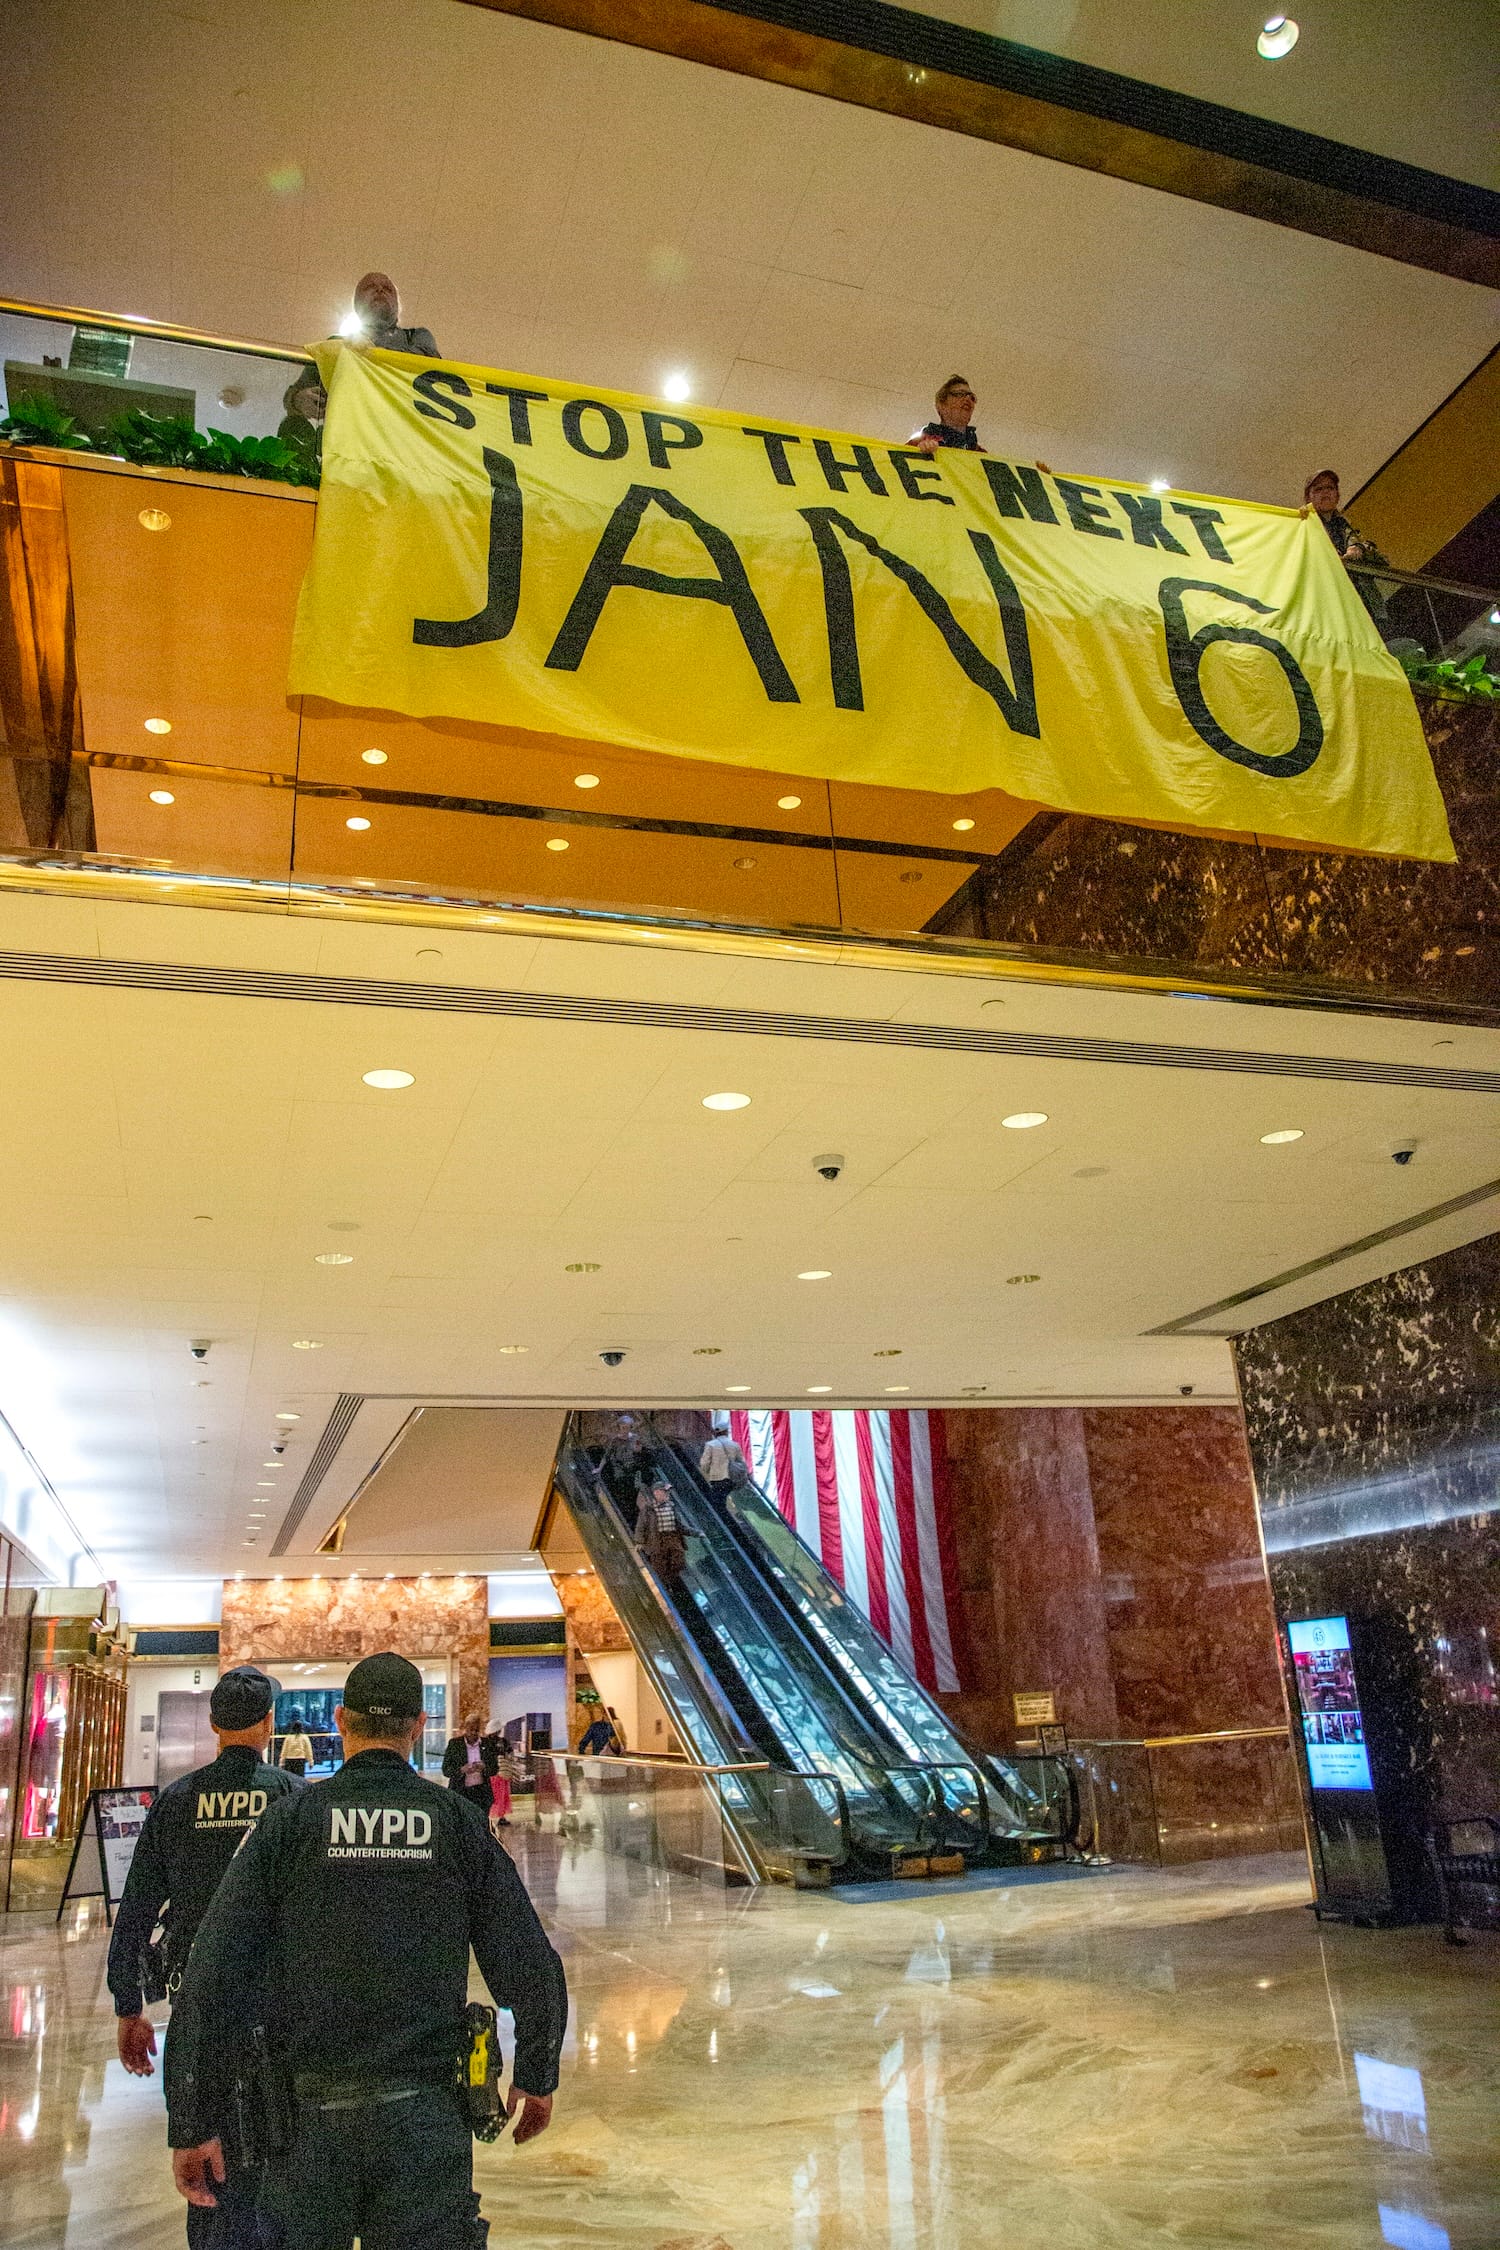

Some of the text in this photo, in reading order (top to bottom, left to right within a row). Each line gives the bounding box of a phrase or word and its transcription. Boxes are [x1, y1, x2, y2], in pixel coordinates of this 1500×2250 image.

[412, 370, 1234, 565] STOP THE NEXT
[412, 446, 1324, 778] JAN 6
[197, 1790, 268, 1818] NYPD
[330, 1808, 432, 1845] NYPD
[328, 1847, 433, 1860] COUNTERTERRORISM
